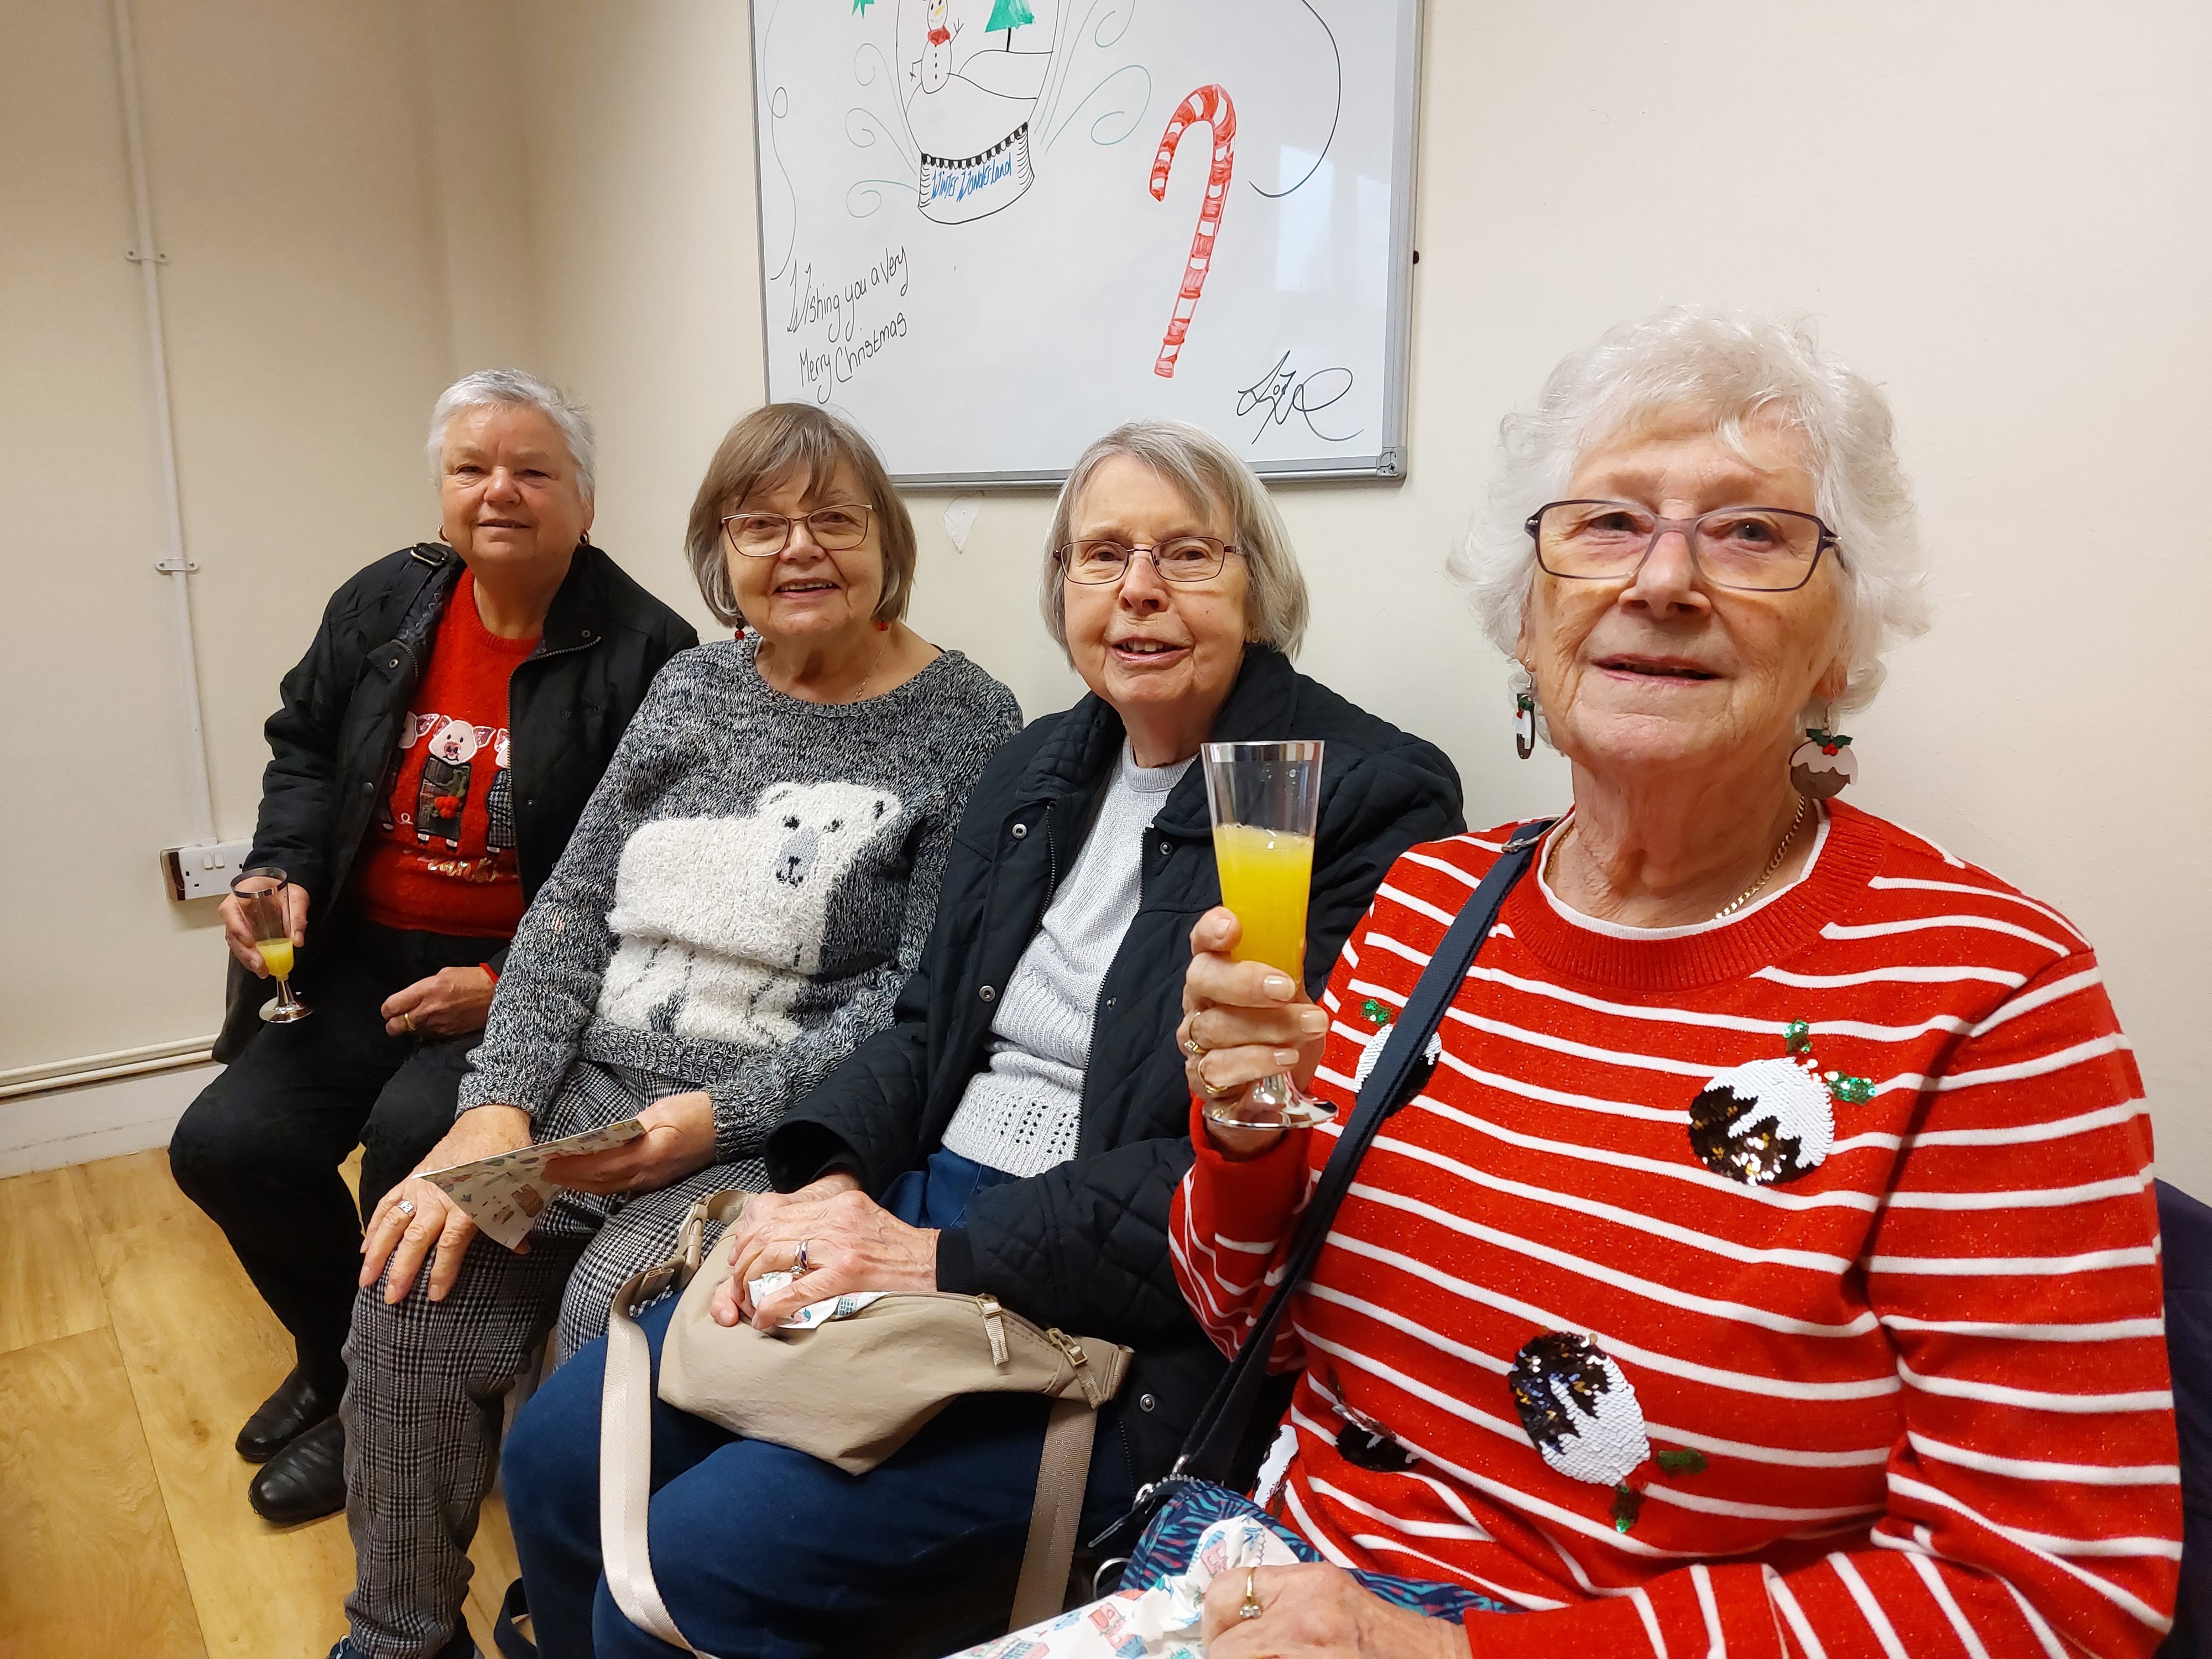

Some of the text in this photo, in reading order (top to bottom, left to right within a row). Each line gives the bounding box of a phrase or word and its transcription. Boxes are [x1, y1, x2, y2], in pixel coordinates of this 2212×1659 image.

[787, 259, 841, 343] Wishing
[845, 278, 867, 342] you
[871, 267, 880, 286] a
[800, 312, 907, 404] Merry Christmas
